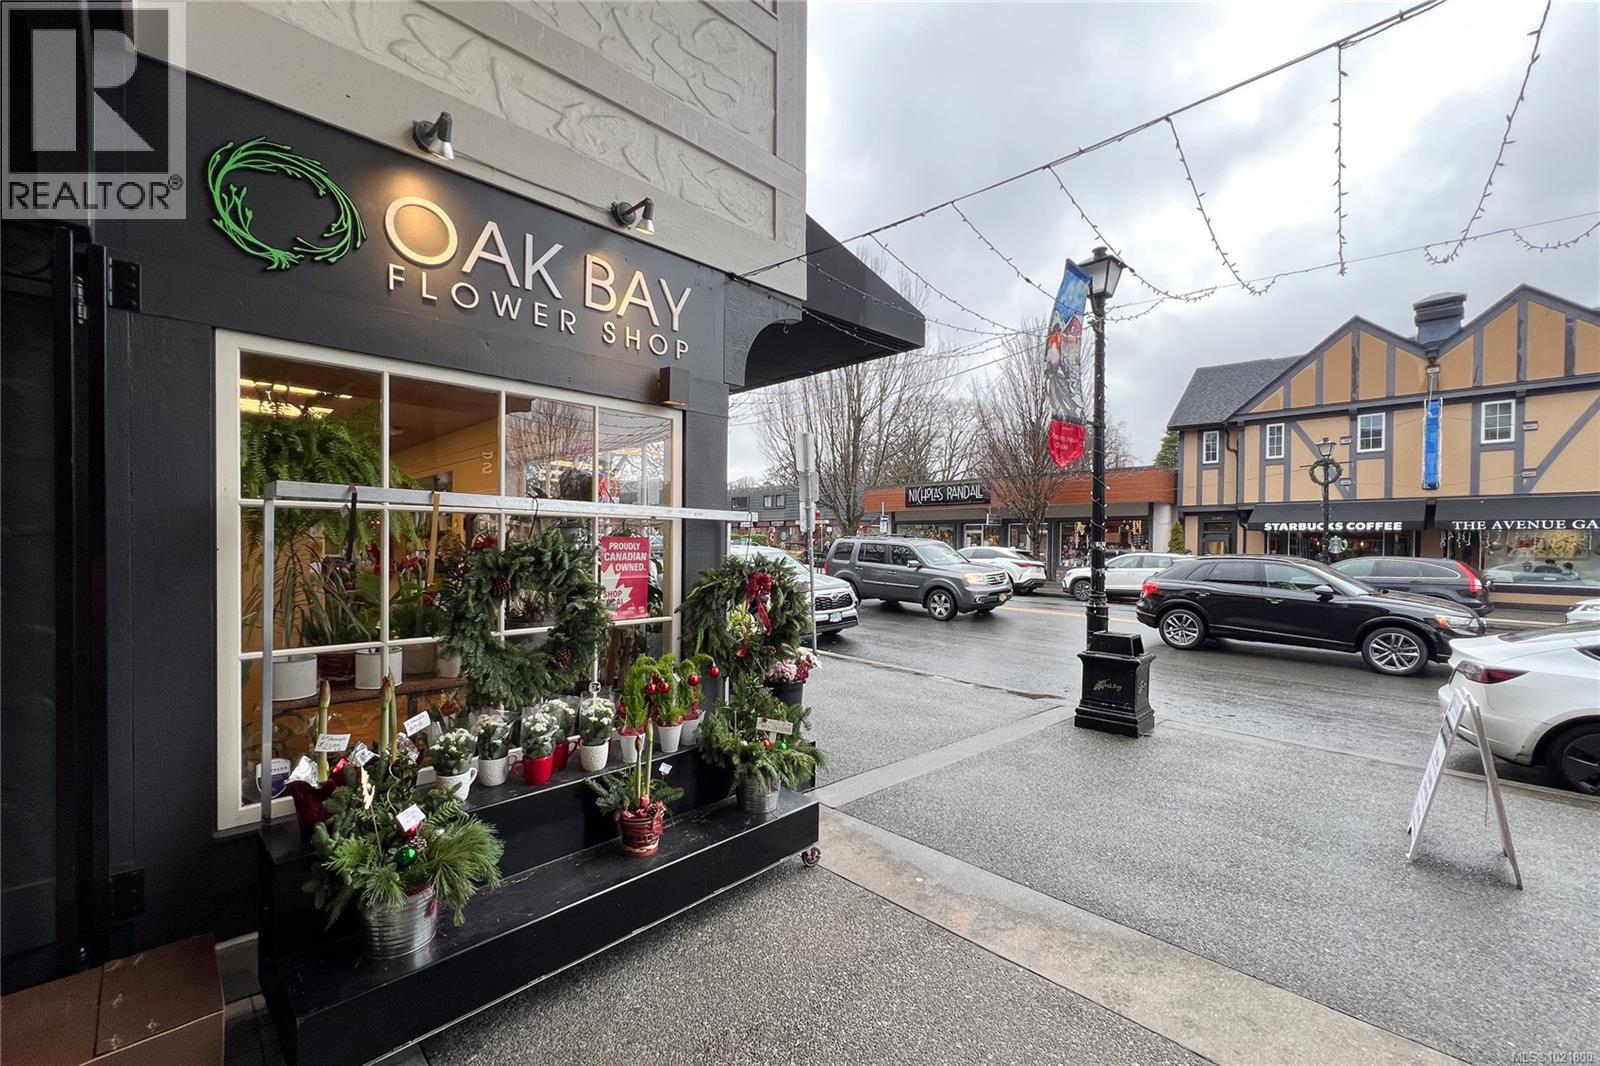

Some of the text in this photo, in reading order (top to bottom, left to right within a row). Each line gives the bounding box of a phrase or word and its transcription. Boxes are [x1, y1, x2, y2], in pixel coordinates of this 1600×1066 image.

[384, 195, 692, 332] OAK BAY
[387, 262, 689, 360] FLOWER SHOP
[908, 485, 983, 504] NICHOLAS RANDALL
[1263, 521, 1403, 532] STARBUCKS COFFEE
[1452, 520, 1487, 531] THE
[1491, 519, 1567, 530] AVENUE
[608, 542, 641, 550] PROUDLY
[604, 552, 647, 561] CANADIAN
[615, 563, 646, 572] OWNED.
[603, 591, 623, 599] SHOP
